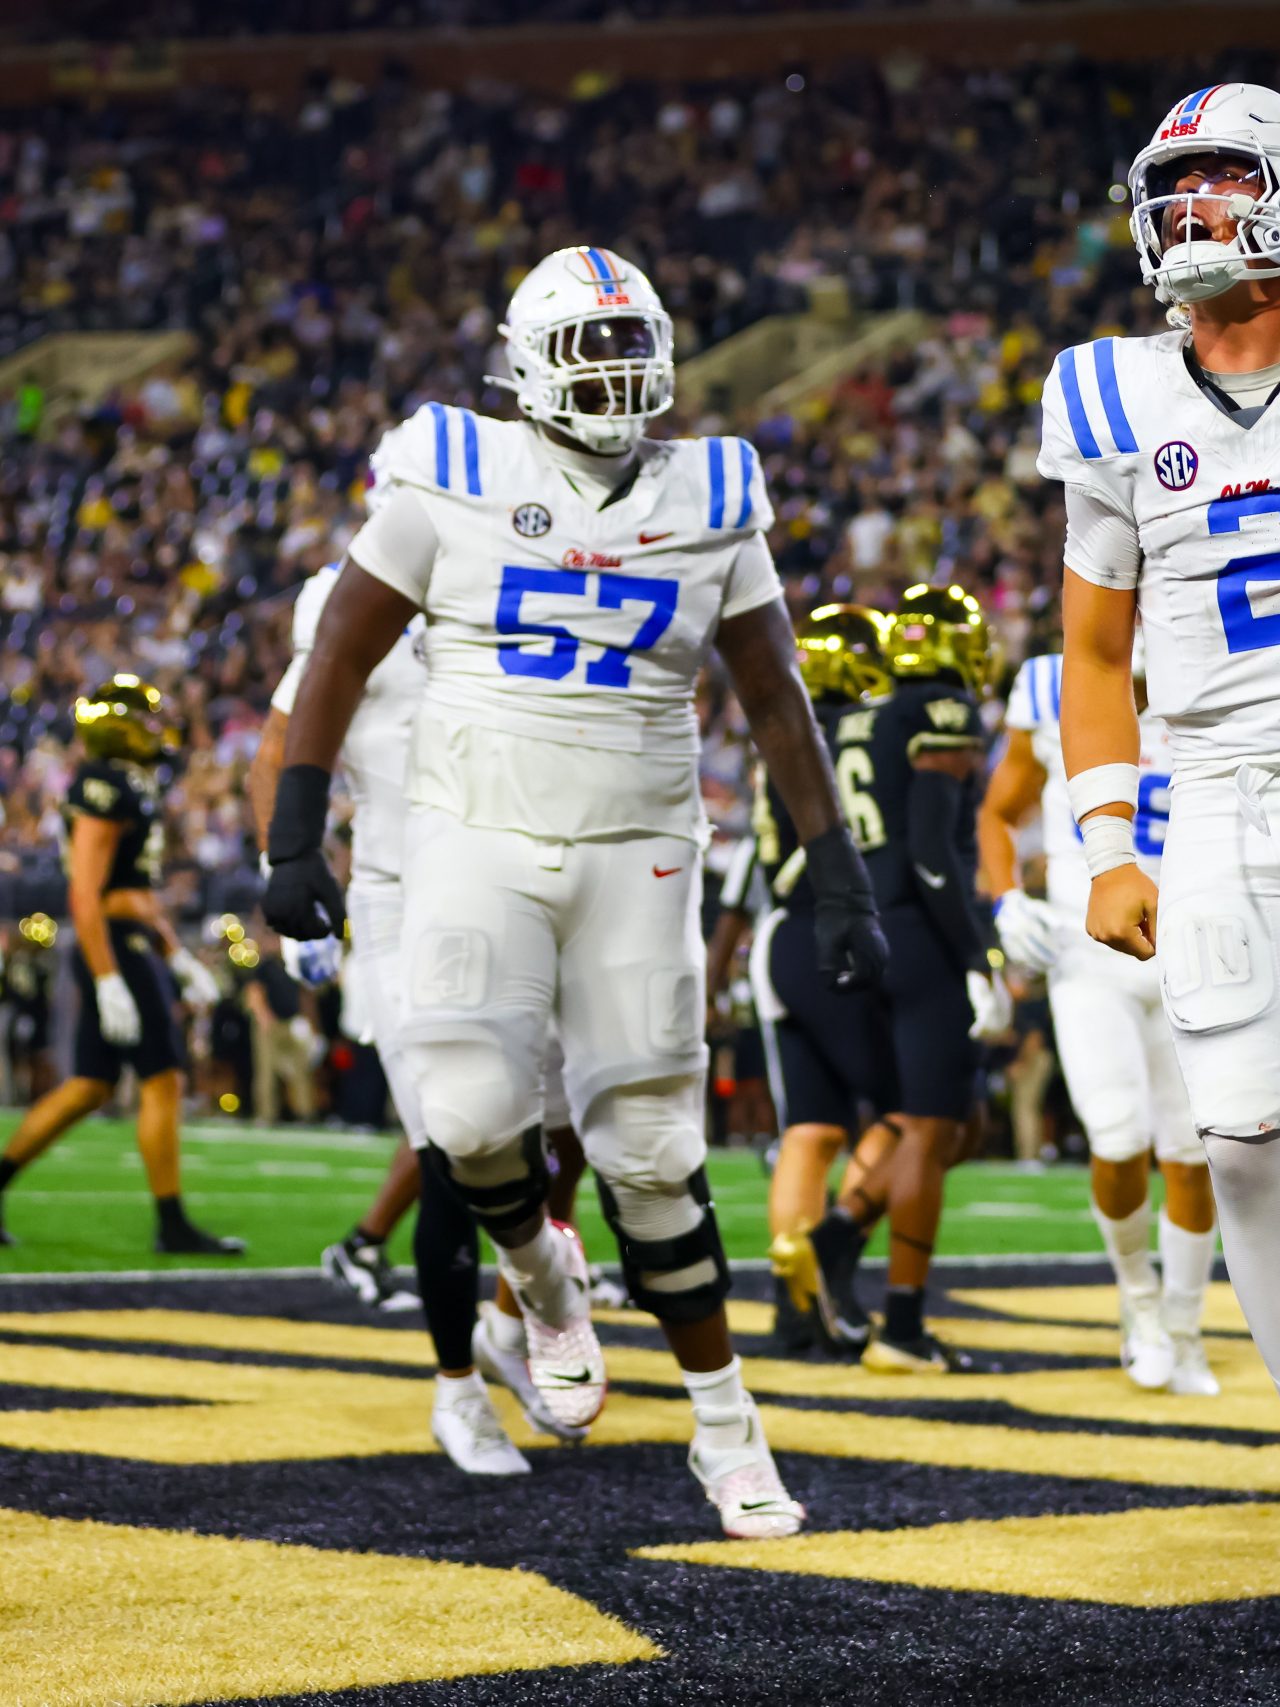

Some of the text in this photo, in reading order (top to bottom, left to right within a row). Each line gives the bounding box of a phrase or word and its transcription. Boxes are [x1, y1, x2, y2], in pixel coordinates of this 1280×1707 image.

[1157, 444, 1195, 488] SEC
[514, 506, 552, 536] SEC
[561, 547, 623, 569] Ole Miss
[495, 565, 680, 688] 57
